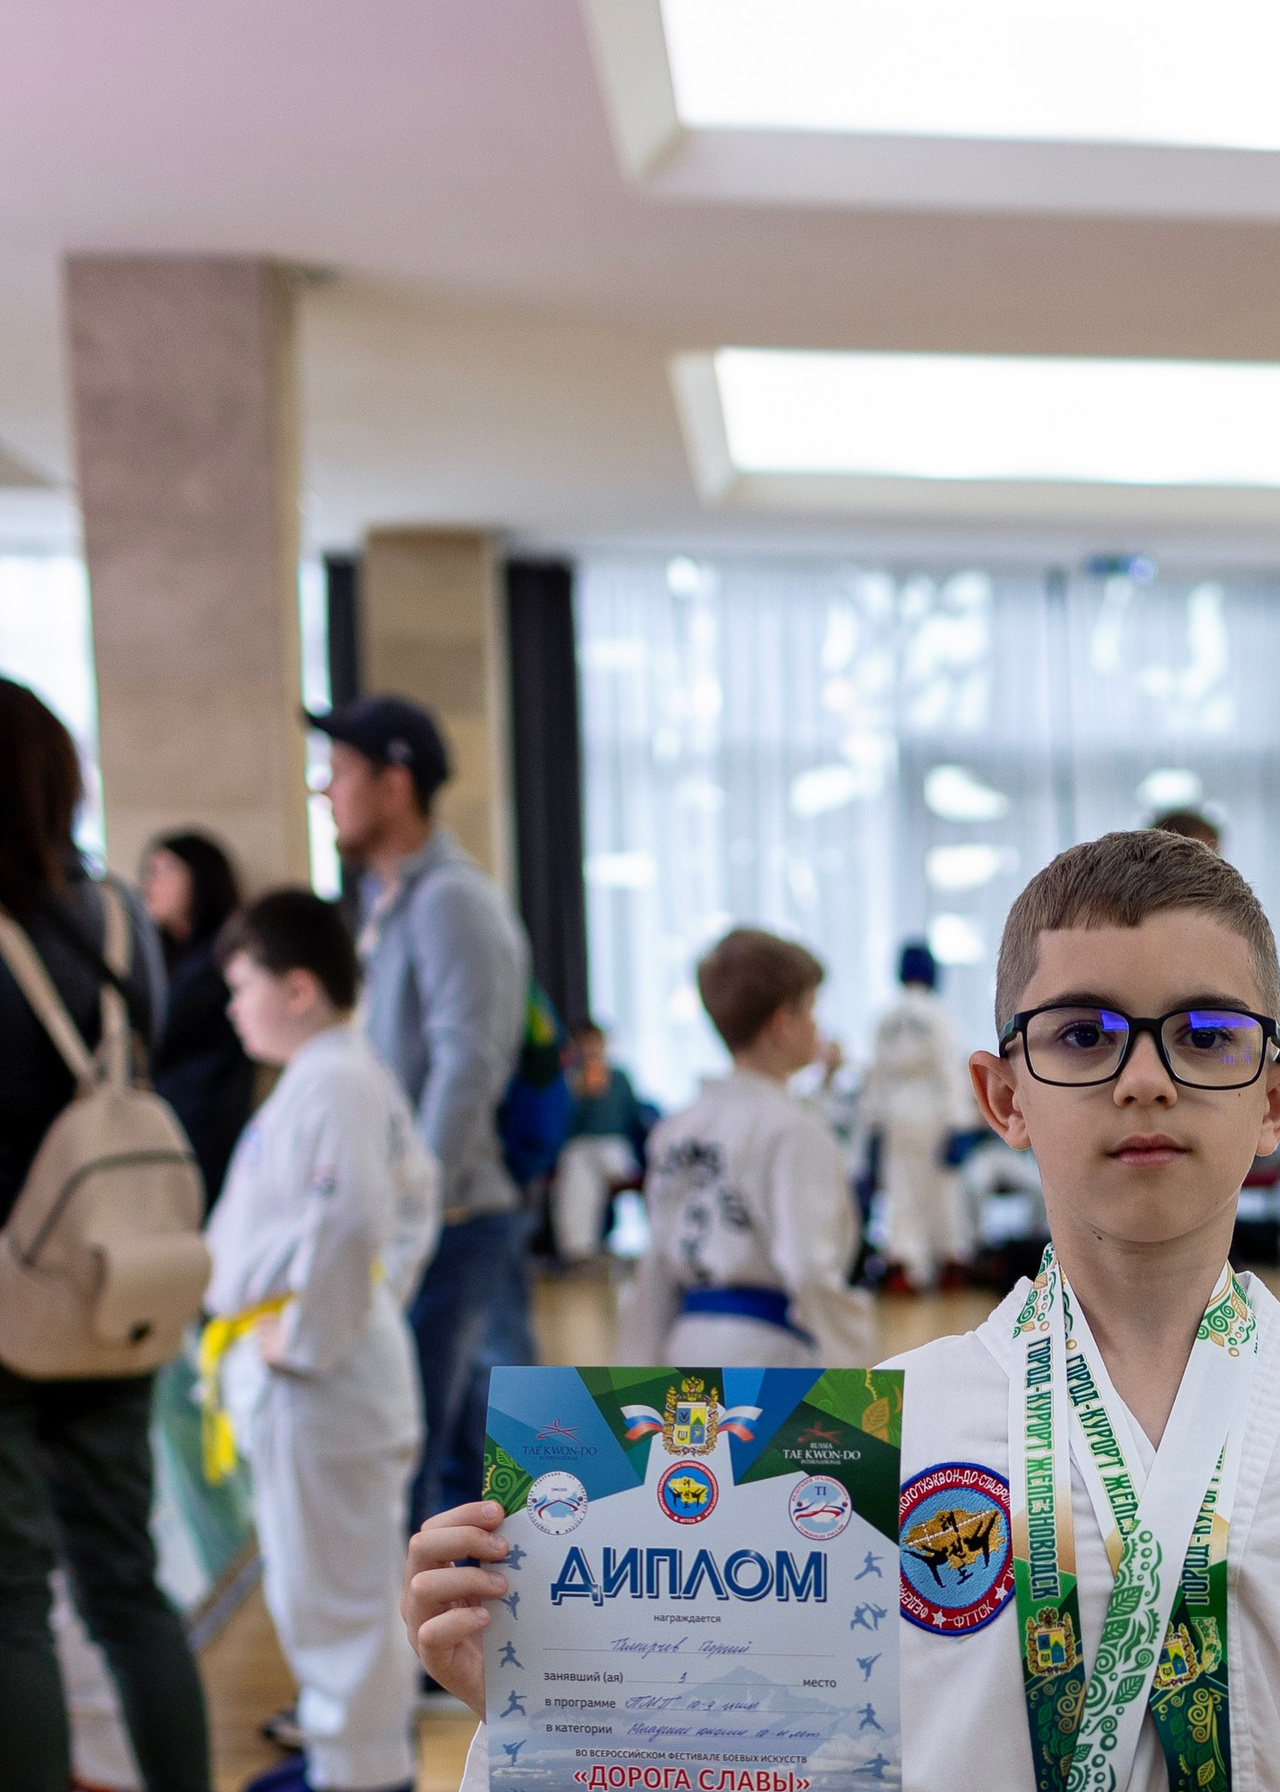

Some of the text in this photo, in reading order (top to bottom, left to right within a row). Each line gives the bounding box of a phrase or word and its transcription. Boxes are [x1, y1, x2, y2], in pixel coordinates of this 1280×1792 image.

[783, 1450, 802, 1459] TAE
[1025, 1336, 1061, 1600] ГОРОД-КУРОРТ ЖЕЛЕЗНОВОДСК
[814, 1486, 827, 1496] TI
[551, 1546, 827, 1606] ДИПЛОМ
[653, 1614, 721, 1624] награждается
[953, 1600, 994, 1627] ФТТСК
[544, 1671, 623, 1684] занявший (ая)
[803, 1680, 837, 1688] место
[554, 1699, 616, 1711] программе
[555, 1725, 612, 1737] категории
[575, 1749, 808, 1764] ВО ВСЕРОССИЙСКОМ ФЕСТИВАЛЕ БОЕВЫХ ИСКУССТВ
[574, 1765, 811, 1792] «ДОРОГА СЛАВЫ»
